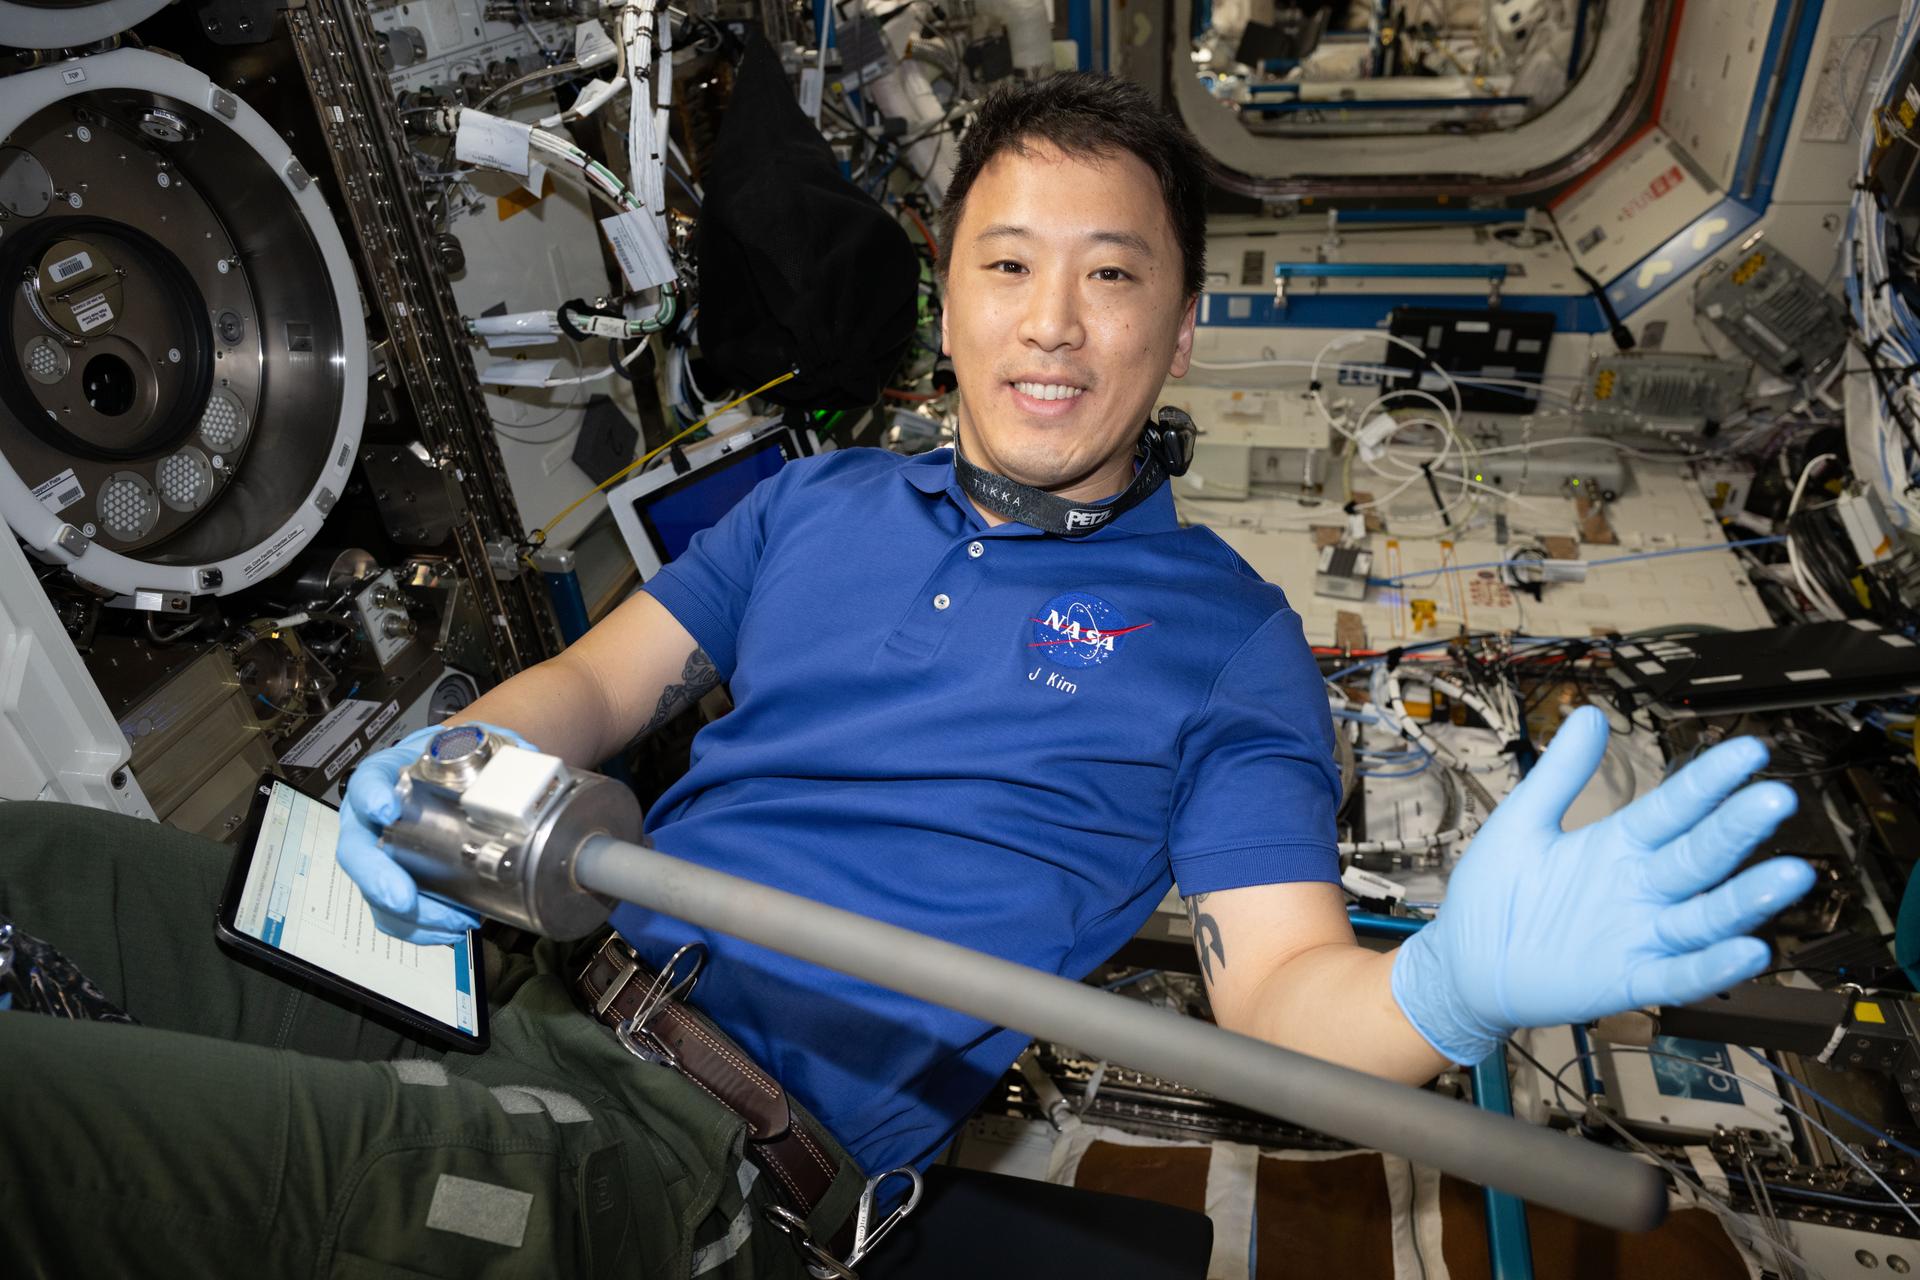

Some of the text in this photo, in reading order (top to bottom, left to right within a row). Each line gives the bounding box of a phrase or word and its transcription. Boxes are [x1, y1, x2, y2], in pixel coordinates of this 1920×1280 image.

[68, 71, 79, 79] TOP
[48, 476, 61, 485] Plate
[972, 480, 1021, 506] TIKKA
[1067, 509, 1110, 530] PETZL
[251, 558, 261, 566] Core
[260, 549, 273, 559] Facility
[272, 537, 288, 550] Chamber
[287, 530, 298, 539] Cover
[1043, 610, 1114, 651] NASA
[1028, 667, 1077, 694] J Kim
